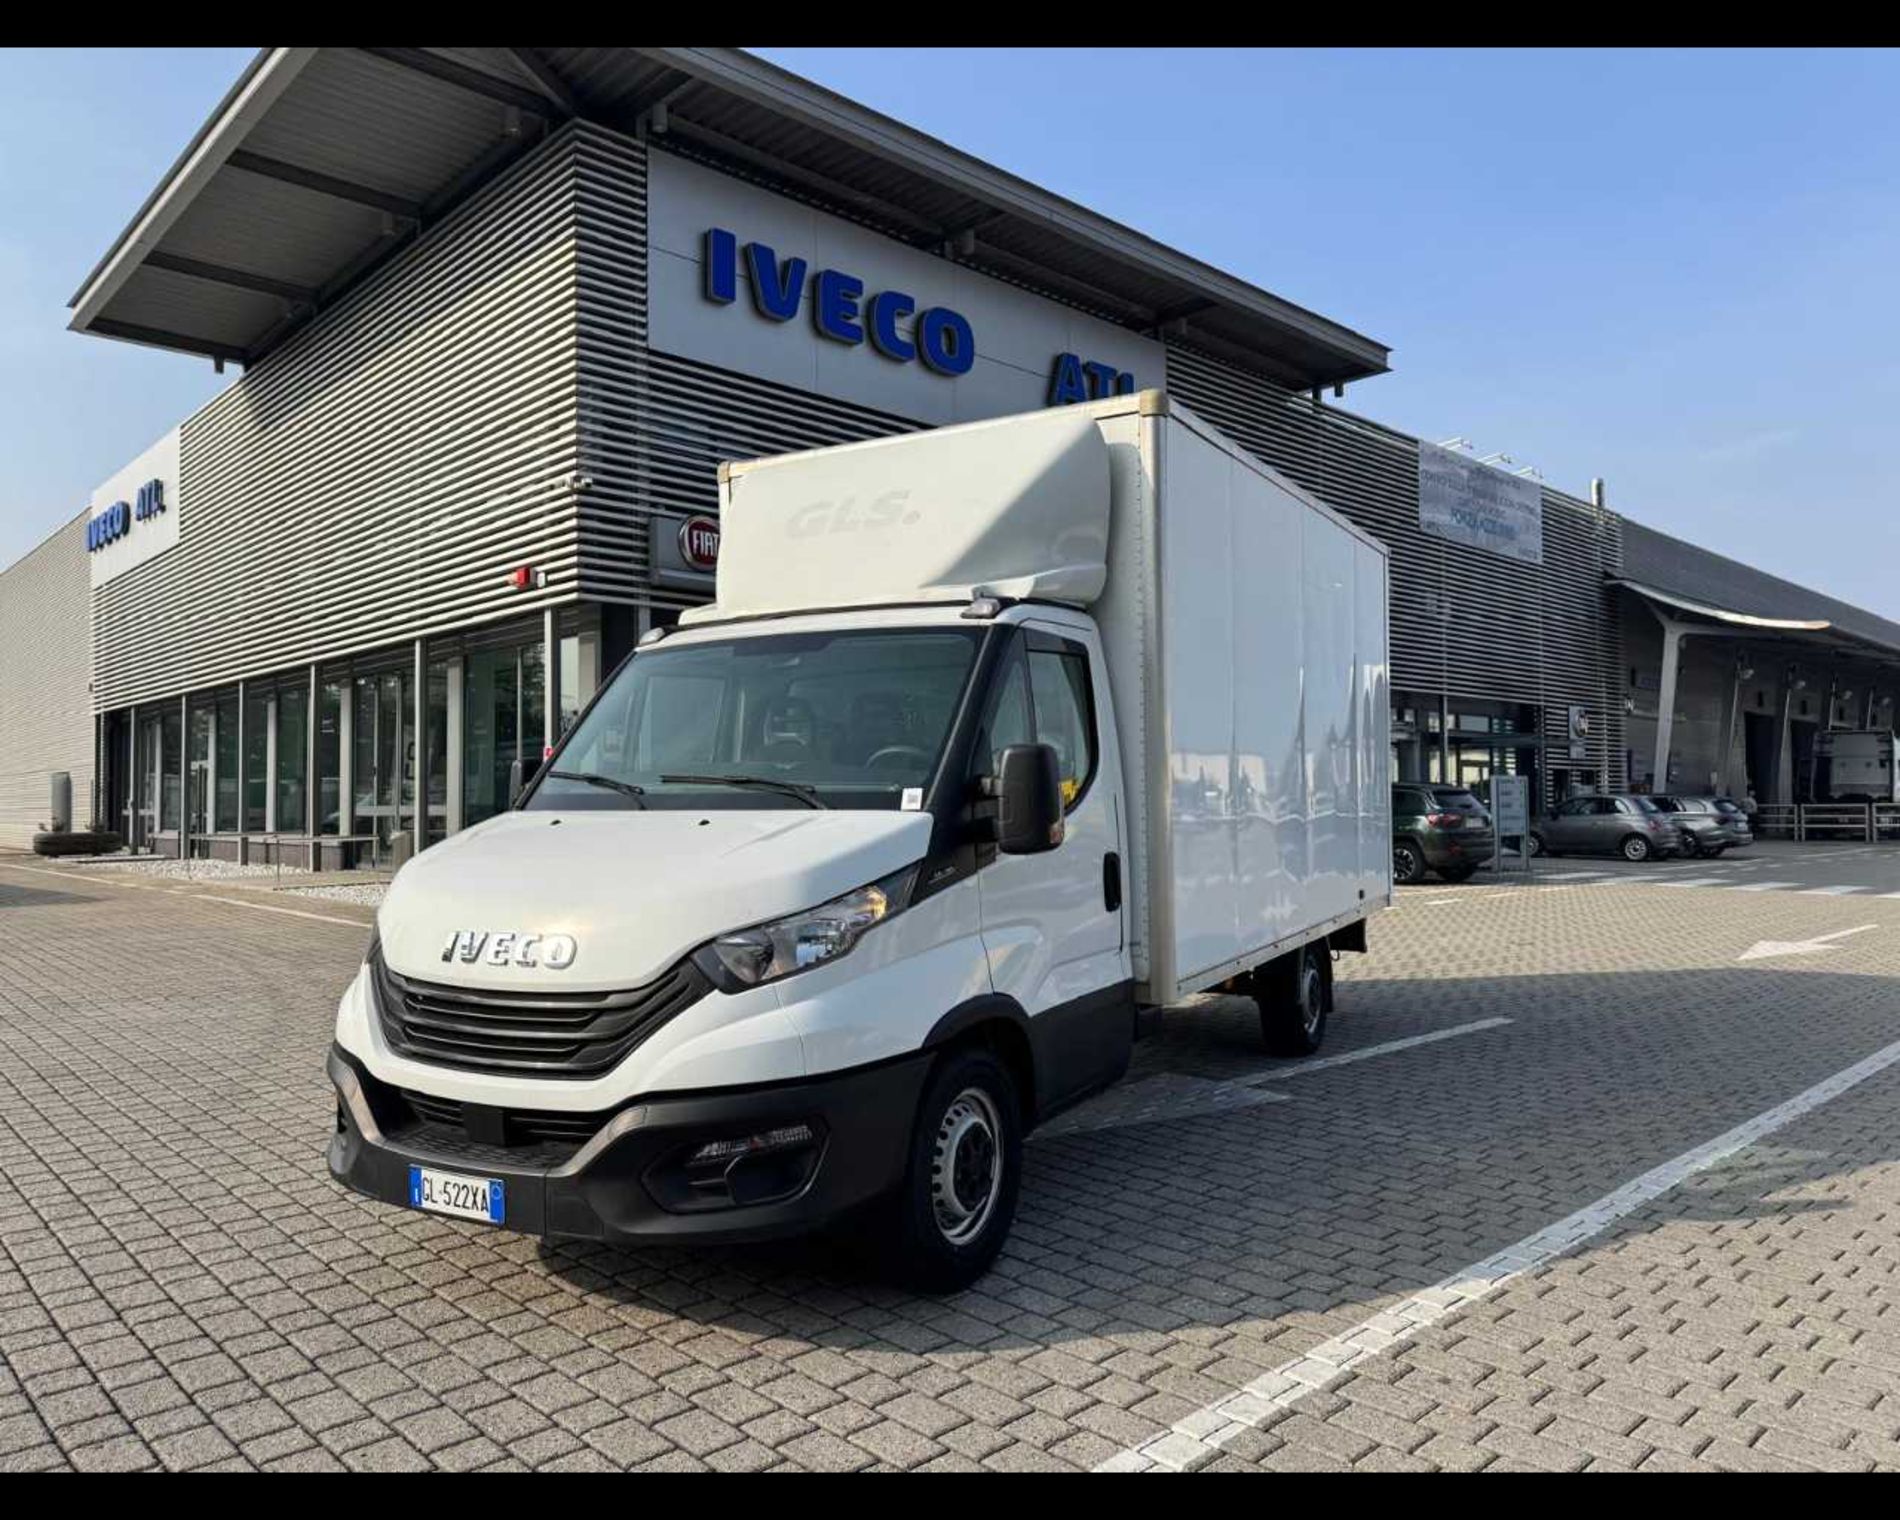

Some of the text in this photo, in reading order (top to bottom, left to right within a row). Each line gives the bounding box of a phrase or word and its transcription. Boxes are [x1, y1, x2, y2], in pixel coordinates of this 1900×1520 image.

[706, 227, 975, 376] IVECO
[87, 500, 130, 552] IVECO
[692, 529, 719, 557] FIAT
[441, 930, 578, 970] IVECO
